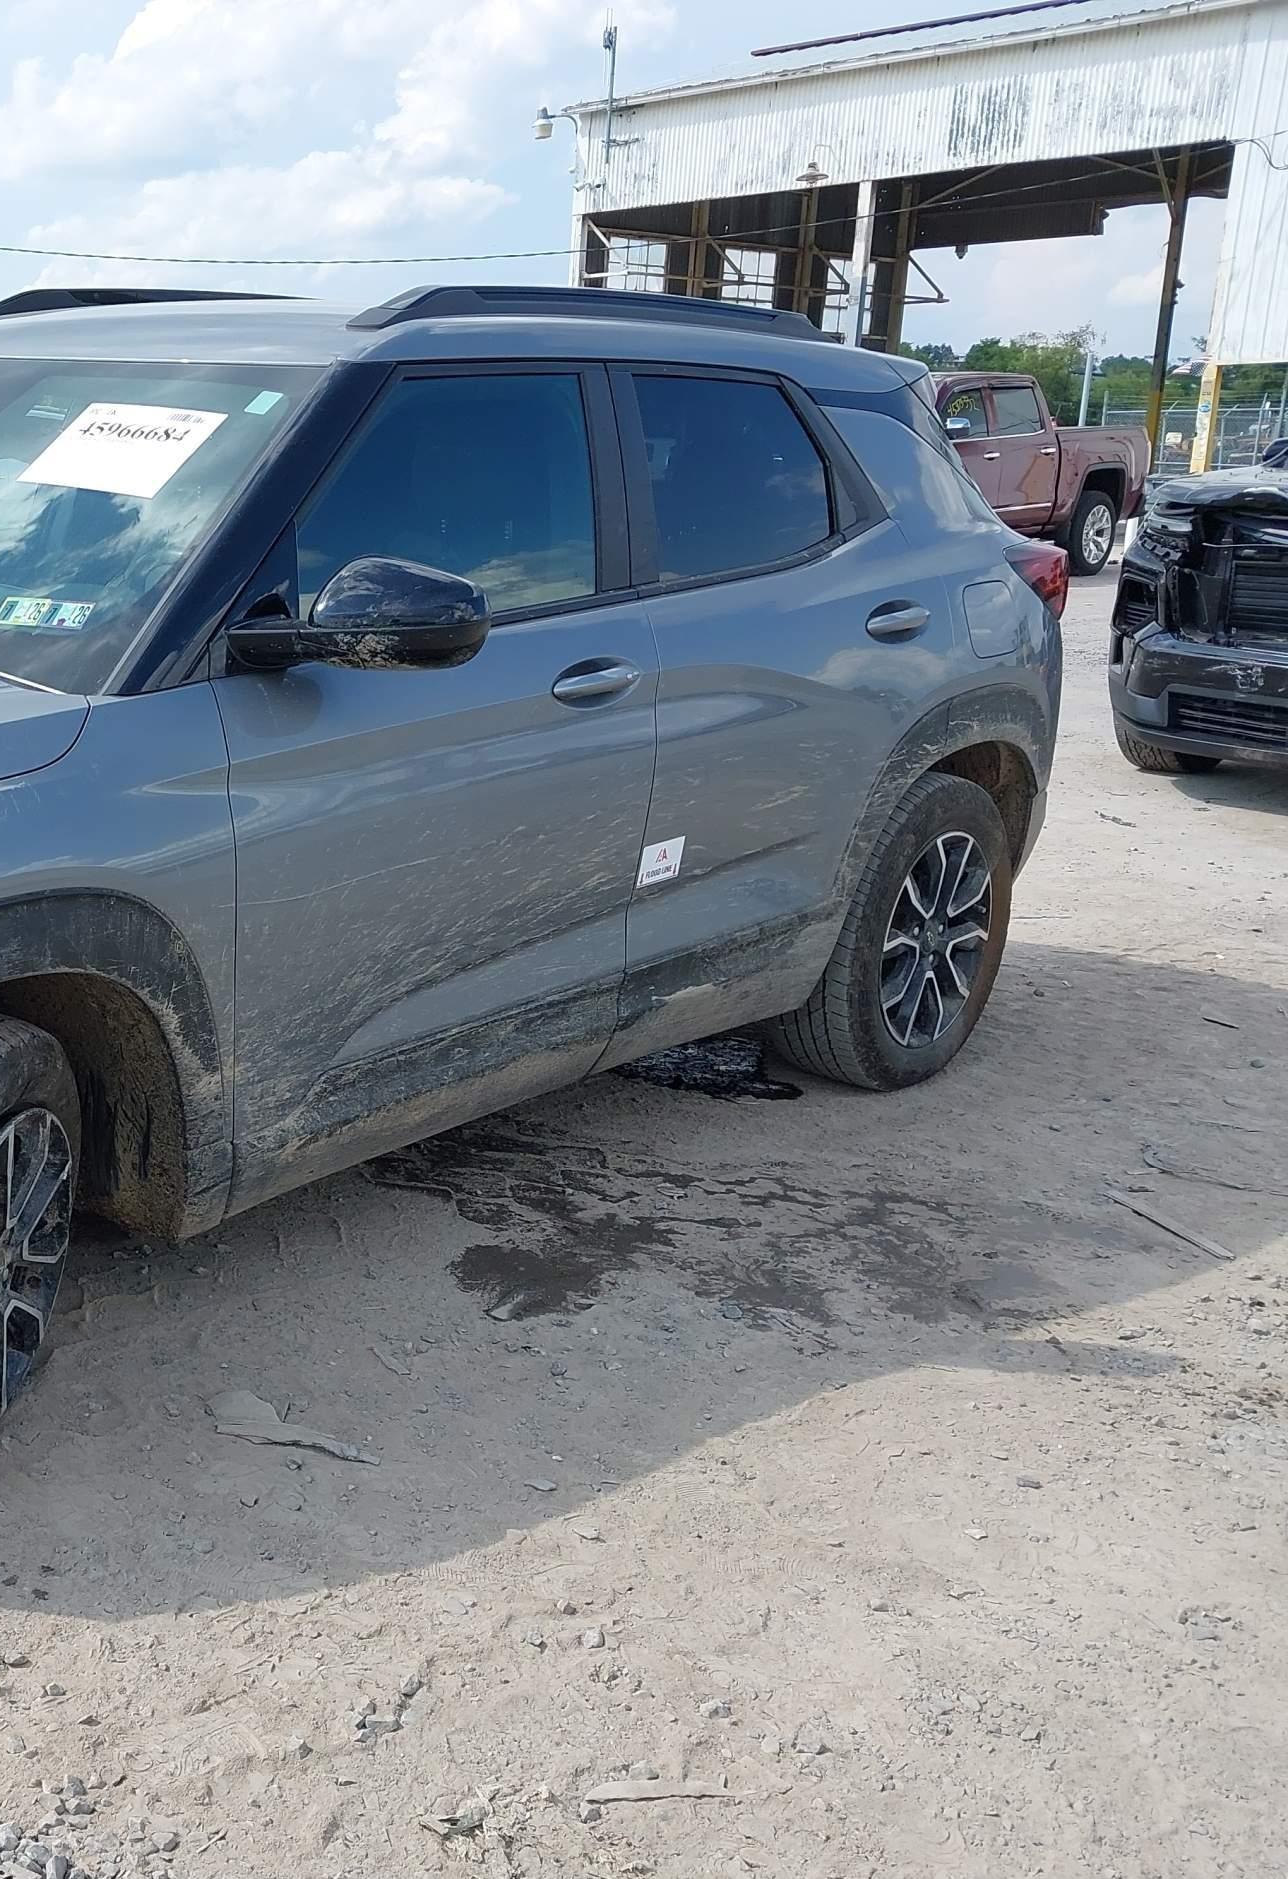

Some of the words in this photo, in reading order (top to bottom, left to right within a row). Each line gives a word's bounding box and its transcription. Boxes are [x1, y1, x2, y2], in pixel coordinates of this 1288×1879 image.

[79, 421, 191, 441] 45966684
[72, 605, 91, 625] 26
[662, 864, 673, 875] LINE
